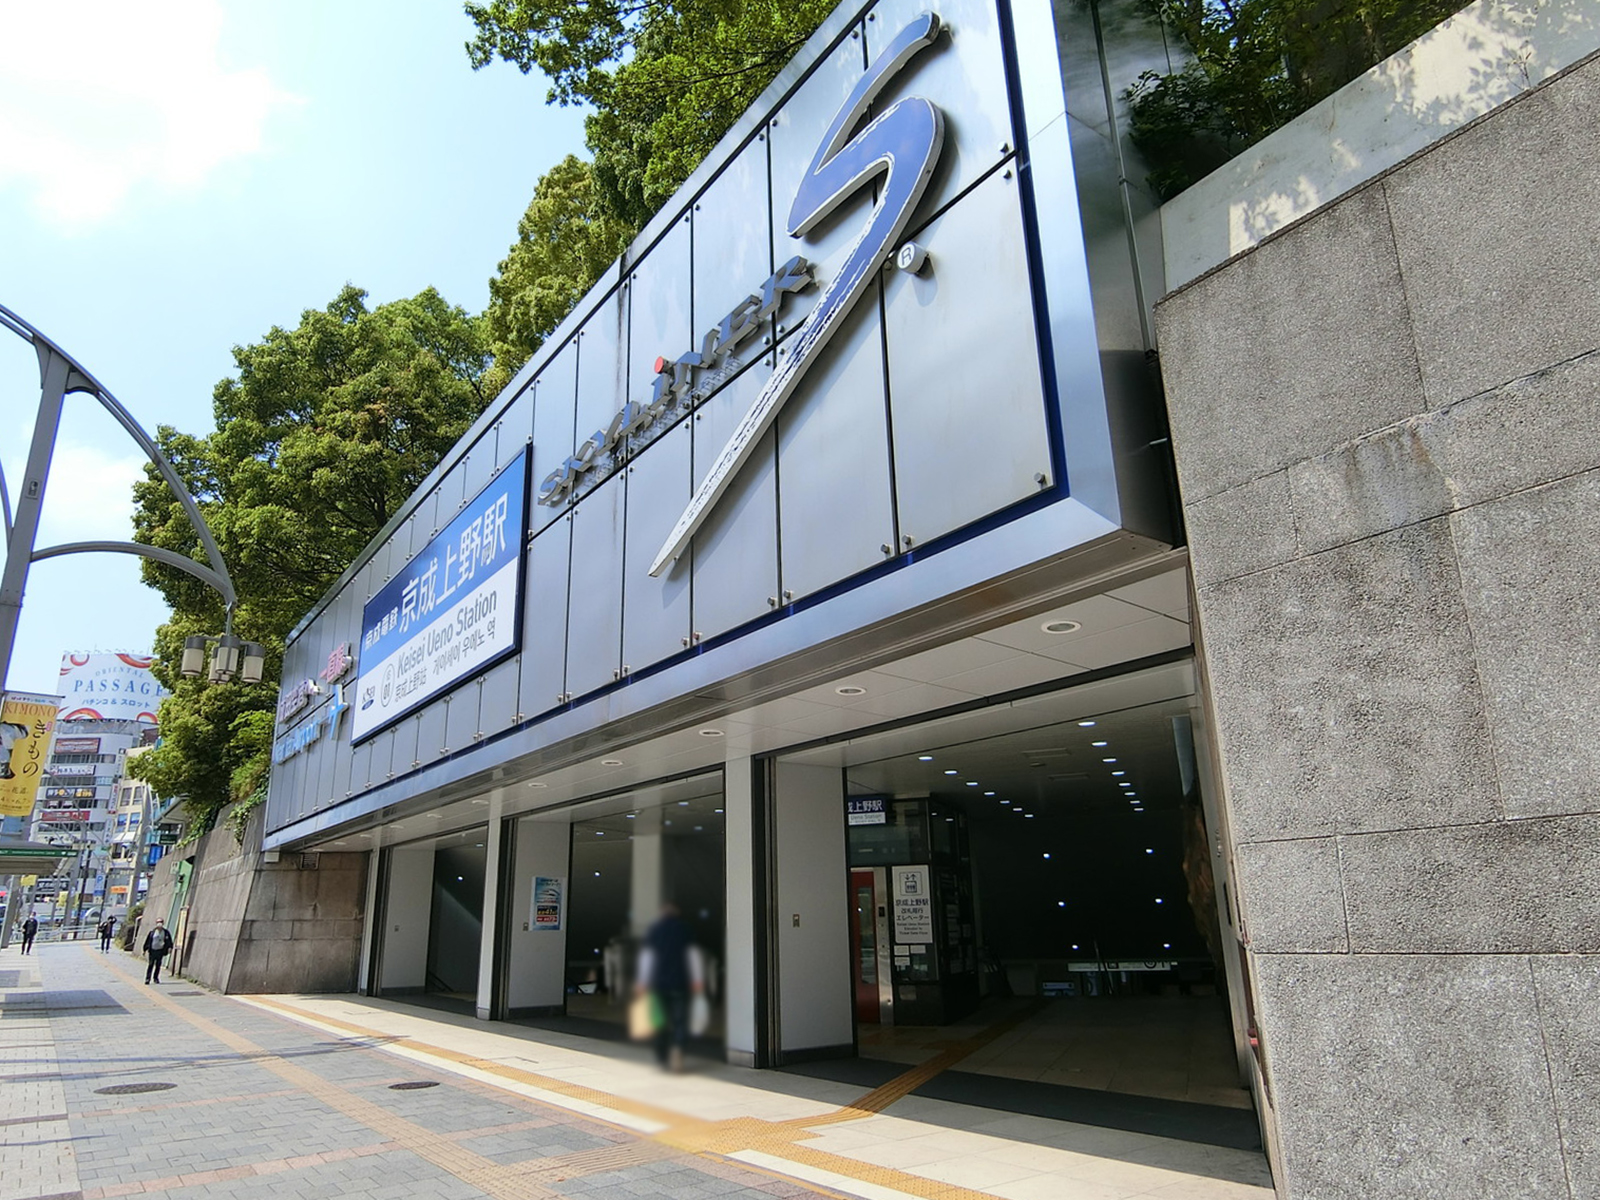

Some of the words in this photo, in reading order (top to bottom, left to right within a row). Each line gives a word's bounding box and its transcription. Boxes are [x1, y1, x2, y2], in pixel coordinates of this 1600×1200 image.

[399, 492, 509, 633] 京成上野駅
[397, 637, 426, 678] Keisei
[427, 623, 454, 657] Ueno
[456, 590, 498, 637] Station
[73, 679, 164, 697] PASSAGE
[95, 666, 144, 678] ORIENTAL
[4, 701, 57, 717] KIMONO
[22, 719, 48, 778] きもの
